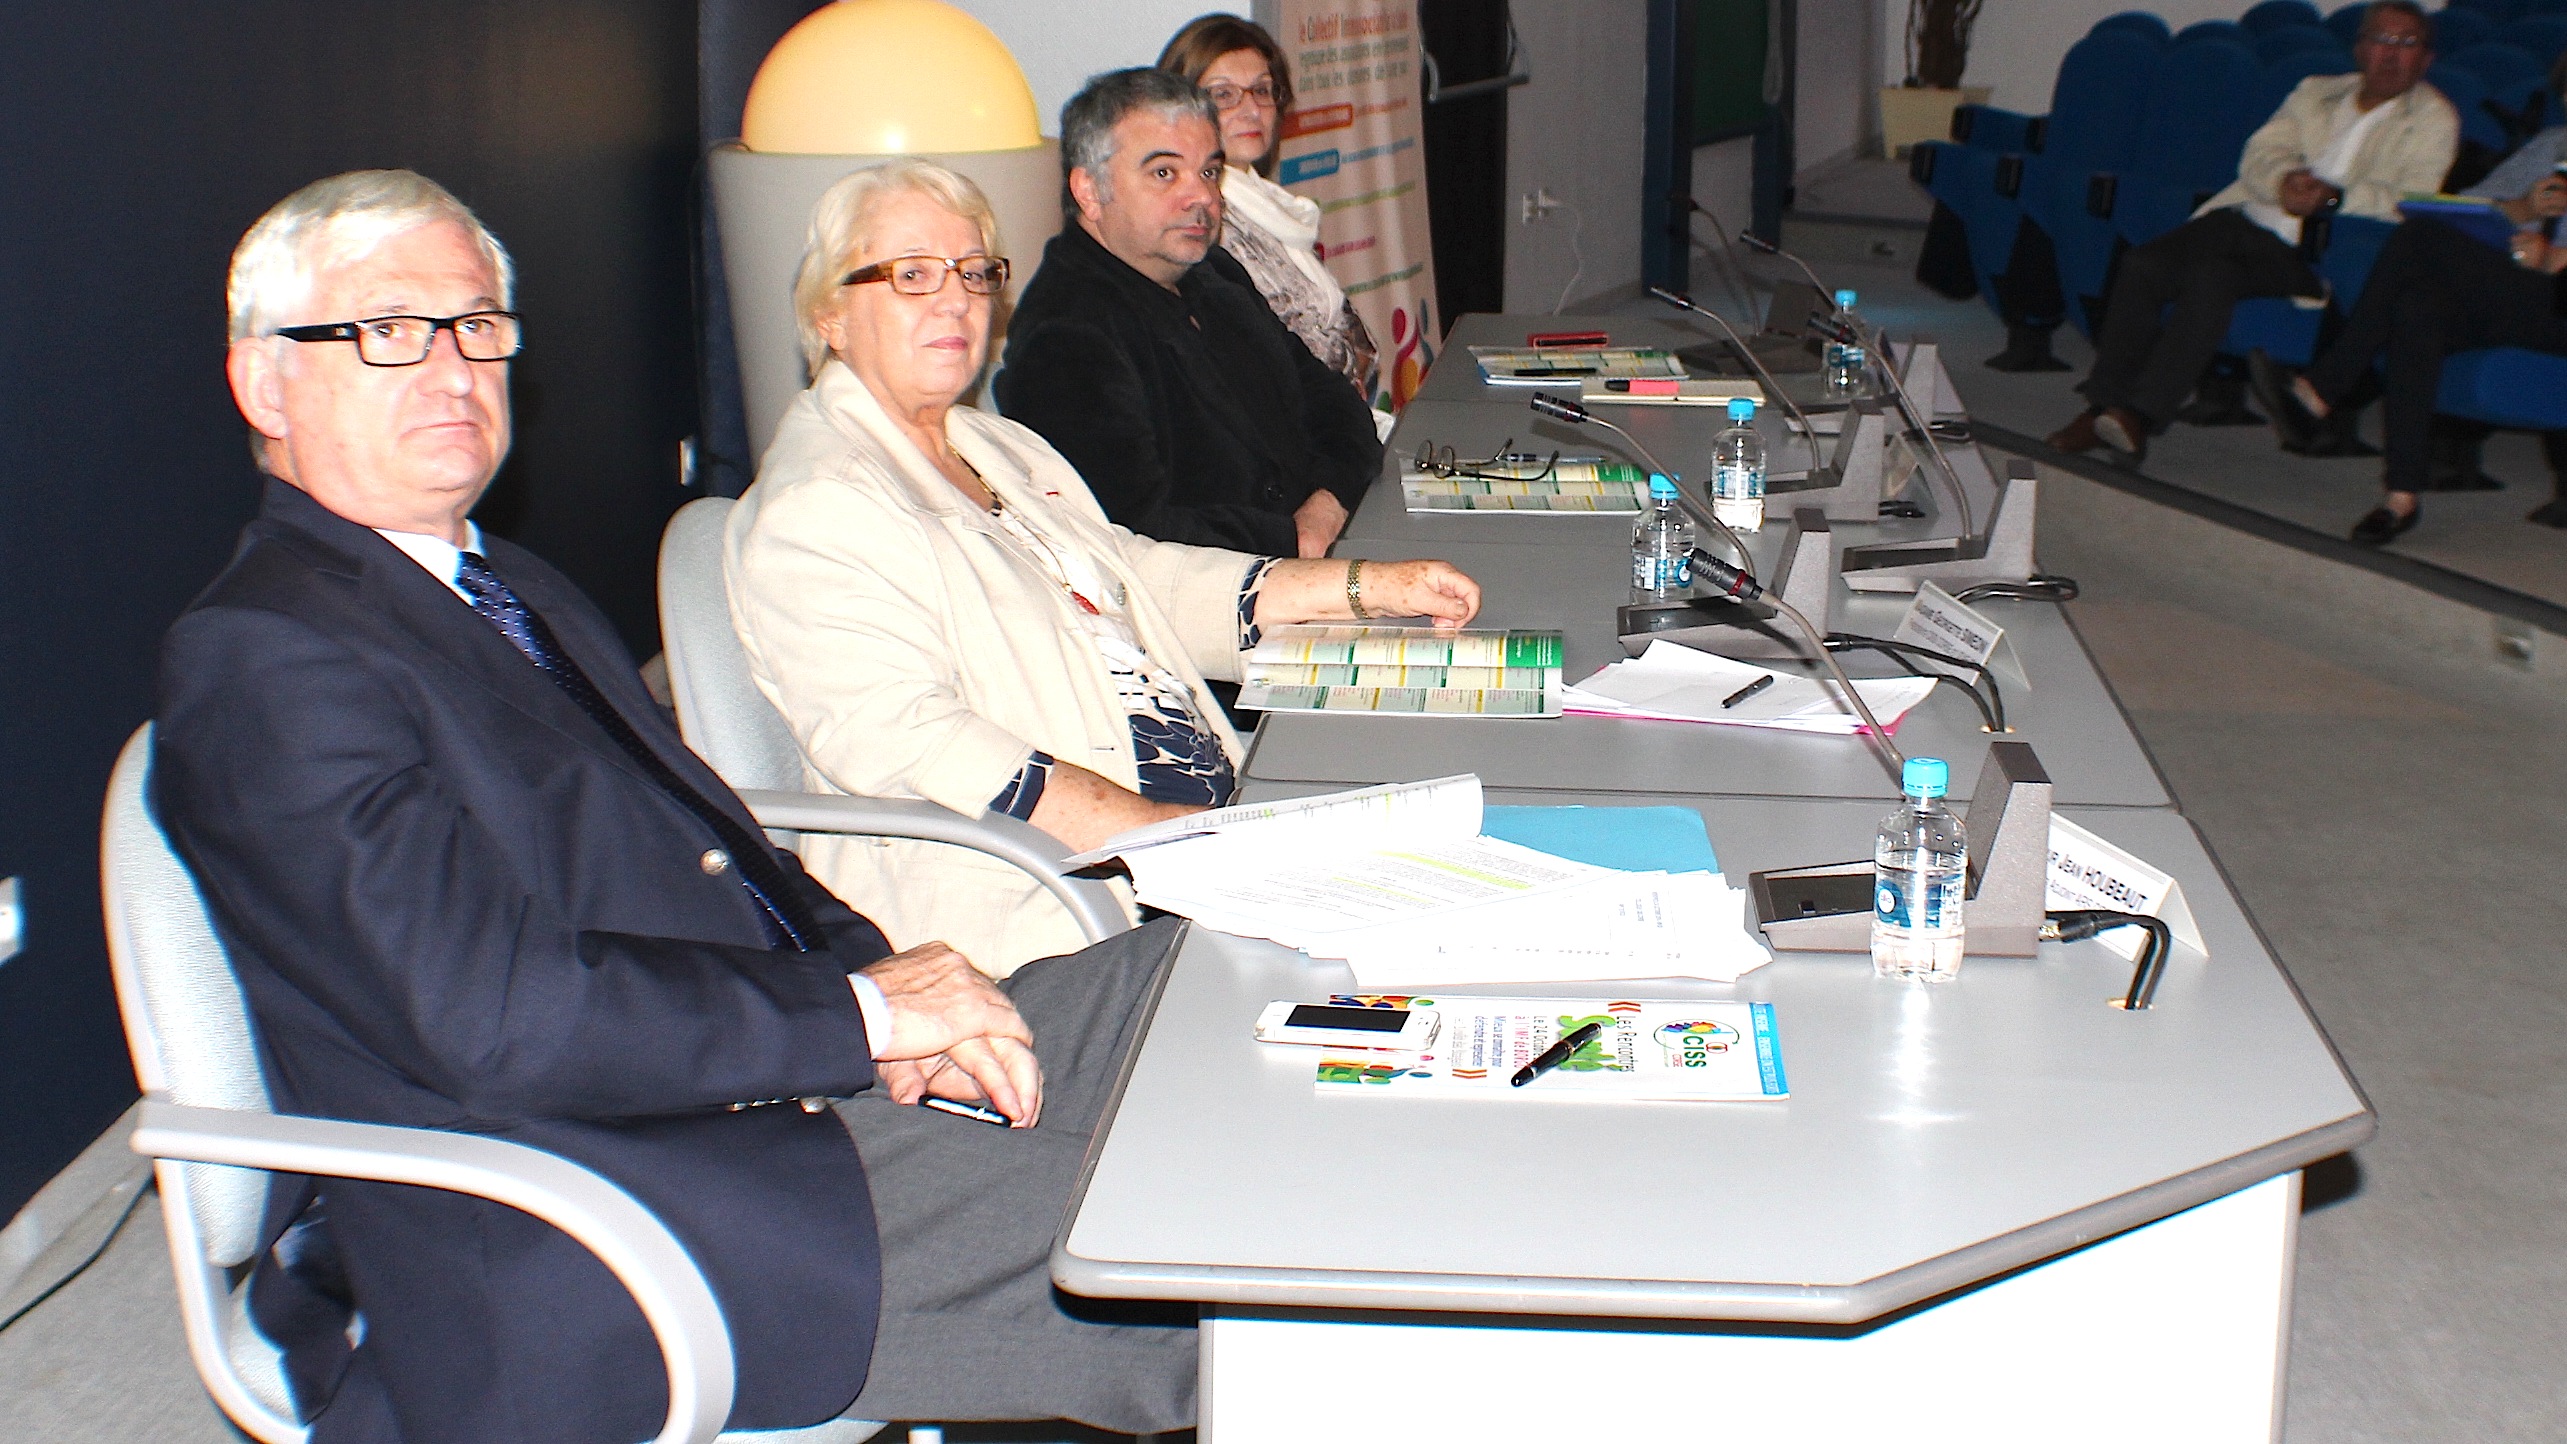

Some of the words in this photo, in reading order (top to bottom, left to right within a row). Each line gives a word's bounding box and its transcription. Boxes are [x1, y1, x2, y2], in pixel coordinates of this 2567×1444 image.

[2081, 865, 2149, 913] HOUBEAUT
[1533, 1015, 1548, 1024] Le
[1616, 1015, 1637, 1030] Les
[1617, 1032, 1639, 1073] Rencontres
[1682, 1035, 1707, 1069] CISS
